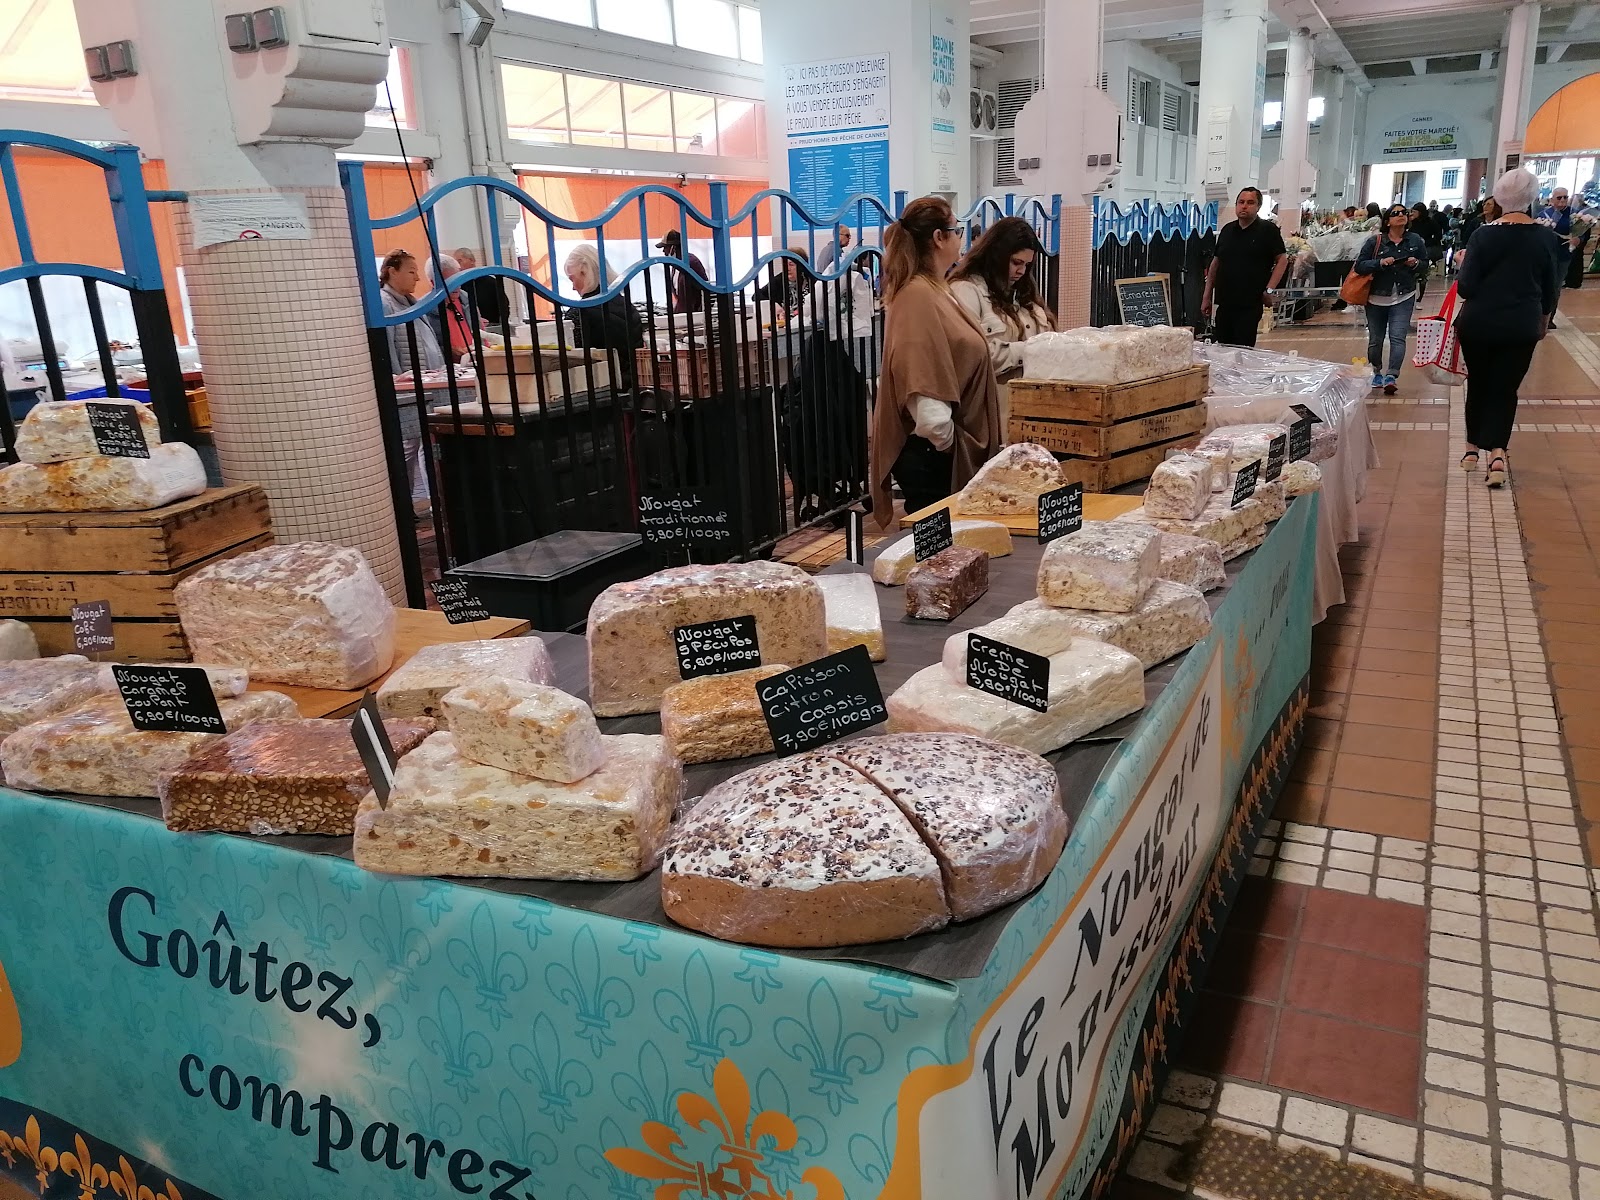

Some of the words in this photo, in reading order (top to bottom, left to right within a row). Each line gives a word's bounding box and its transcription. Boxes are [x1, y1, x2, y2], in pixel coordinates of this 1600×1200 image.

[808, 66, 818, 78] PAS
[821, 65, 828, 77] DE
[830, 62, 854, 76] POISSON
[938, 54, 954, 71] METTRE
[785, 86, 795, 98] LES
[852, 75, 886, 91] S'ENGAGENT
[940, 71, 951, 86] FRAIS
[792, 101, 807, 114] VOUS
[809, 98, 830, 112] VENDRE
[832, 93, 875, 110] EXCLUSIVEMENT
[787, 118, 793, 131] LE
[794, 116, 818, 129] PRODUIT
[820, 115, 827, 128] DE
[829, 114, 842, 127] LEUR
[1384, 129, 1406, 138] FAITES
[1406, 128, 1427, 136] VOTRE
[1428, 125, 1455, 134] MARCHÉ
[260, 222, 306, 230] DANGEREUX
[87, 405, 128, 421] Nougat
[638, 494, 702, 512] Nougat
[1039, 489, 1082, 512] Nougat
[640, 511, 728, 526] traditionnel
[1039, 504, 1082, 524] Lavande
[914, 513, 944, 534] Nougat
[915, 521, 948, 542] Chocolat
[431, 578, 468, 592] Nougat
[436, 588, 468, 603] Caramel
[72, 604, 106, 621] Nougat
[440, 602, 464, 612] Beurre
[74, 620, 96, 634] Café
[677, 621, 743, 643] Nougat
[117, 669, 180, 686] Nougat
[762, 664, 851, 702] Calisson
[970, 658, 1044, 692] Nougat
[121, 681, 187, 696] Caramel
[769, 688, 834, 718] Citron
[800, 694, 867, 724] Cassis
[982, 996, 1045, 1176] Le
[1060, 742, 1187, 1010] Nougat
[1192, 692, 1210, 772] de
[108, 885, 381, 1048] Goûtez,
[1011, 803, 1200, 1200] Montségur
[179, 1053, 536, 1200] comparez
